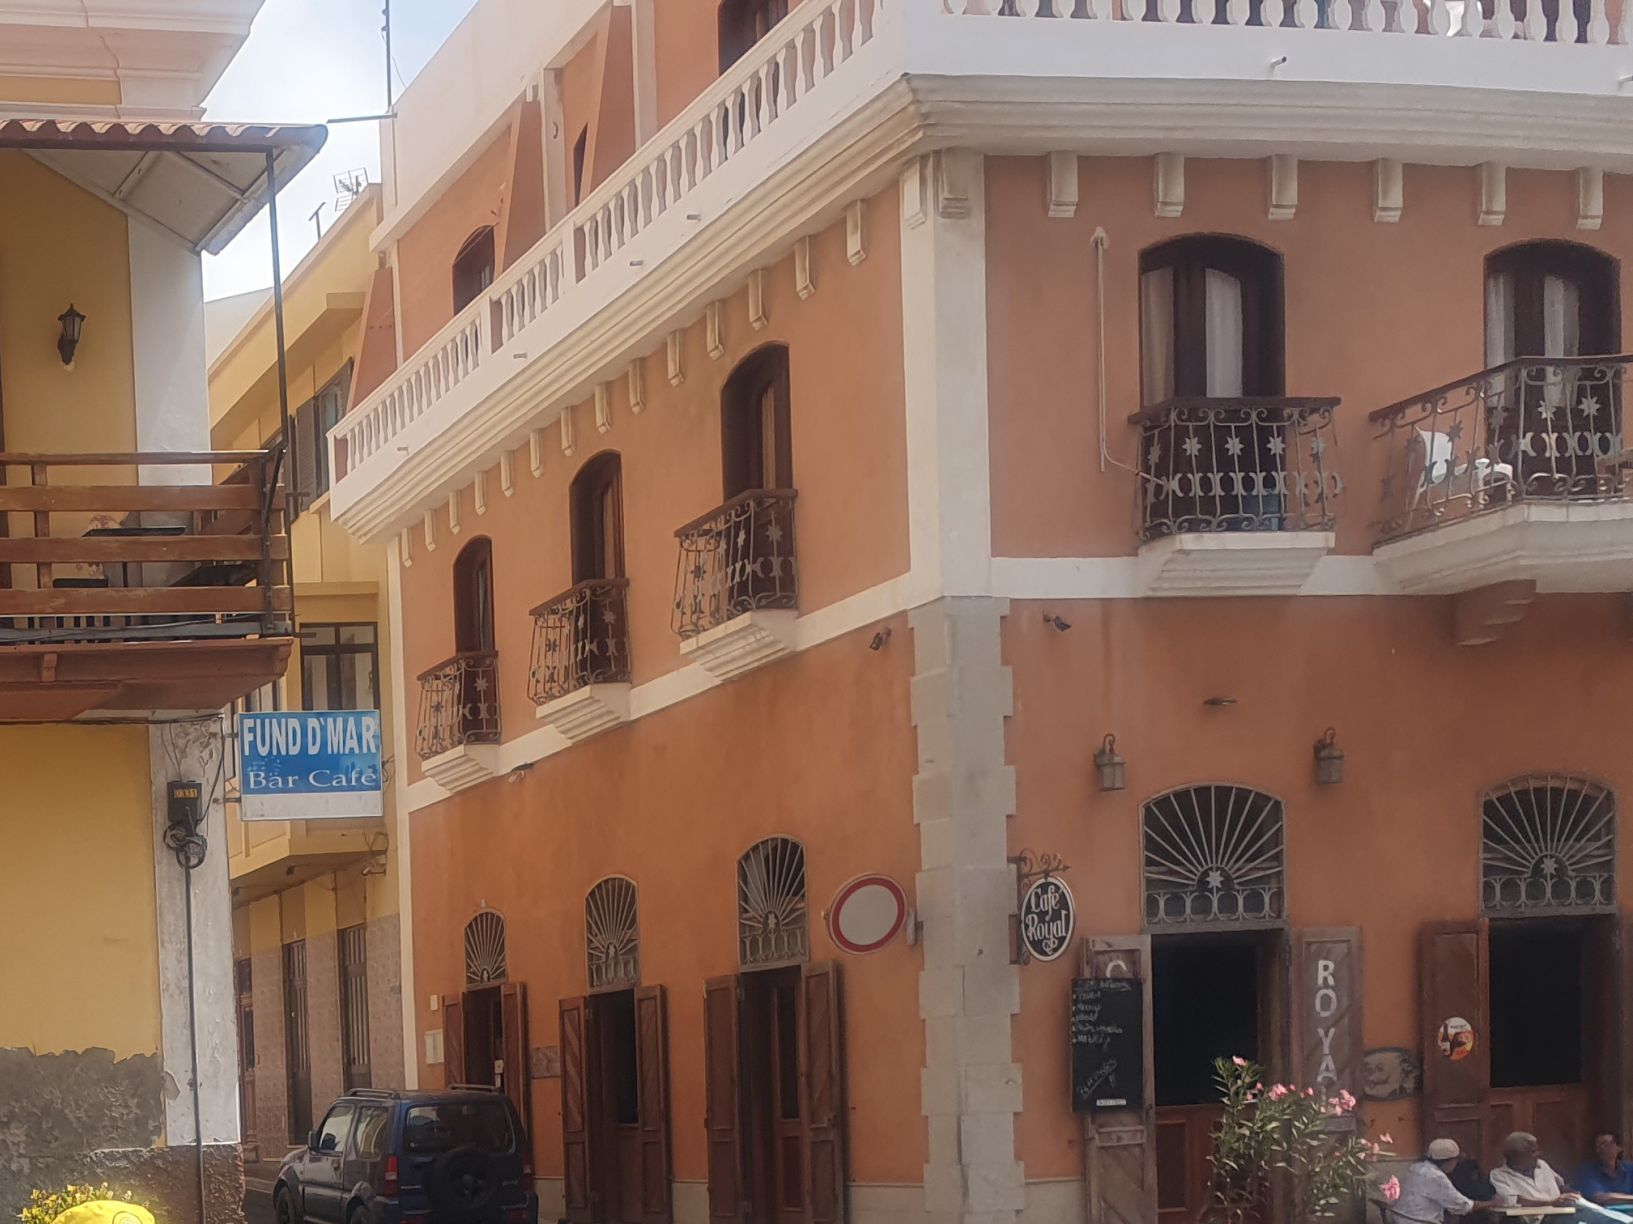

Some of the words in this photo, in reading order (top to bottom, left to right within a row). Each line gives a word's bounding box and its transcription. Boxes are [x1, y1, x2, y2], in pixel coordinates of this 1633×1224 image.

[243, 718, 302, 756] FUND
[308, 768, 377, 787] Café
[1030, 885, 1063, 921] Café
[1025, 909, 1068, 953] Royal
